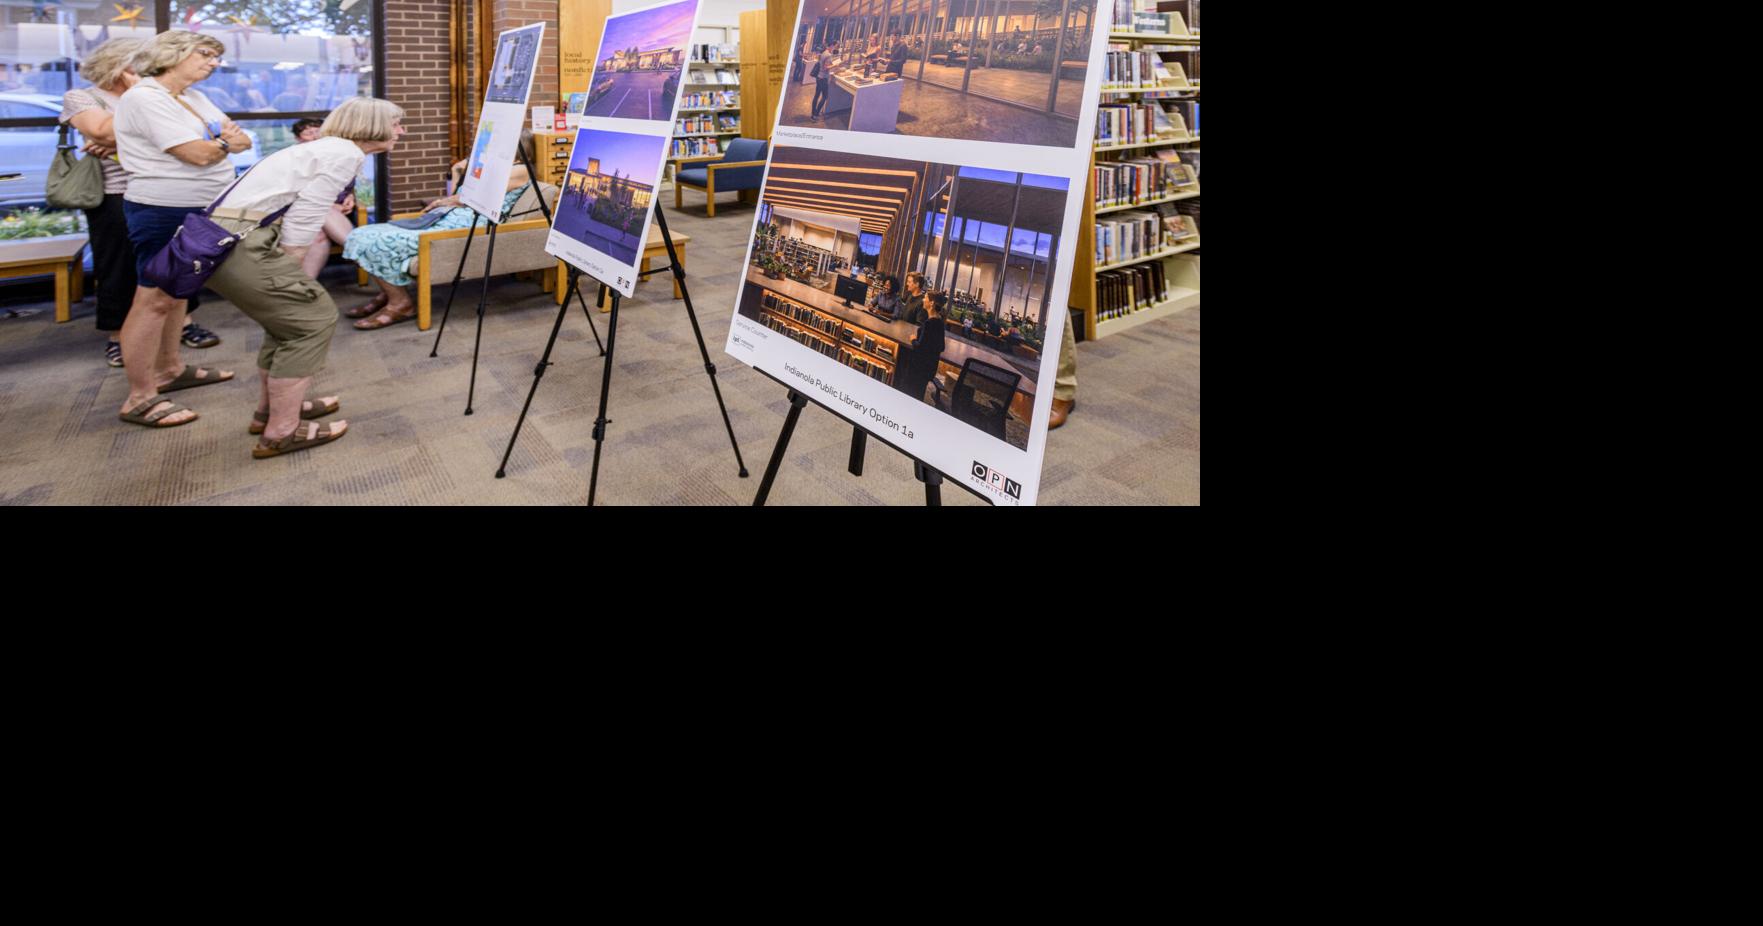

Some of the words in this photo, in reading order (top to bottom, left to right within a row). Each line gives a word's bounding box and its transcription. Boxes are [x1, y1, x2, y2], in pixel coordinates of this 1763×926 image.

[784, 362, 815, 386] Indianola
[815, 378, 838, 399] Public
[839, 392, 868, 415] Library
[869, 407, 900, 432] Option
[901, 425, 915, 440] 1a
[972, 462, 1020, 499] OPN
